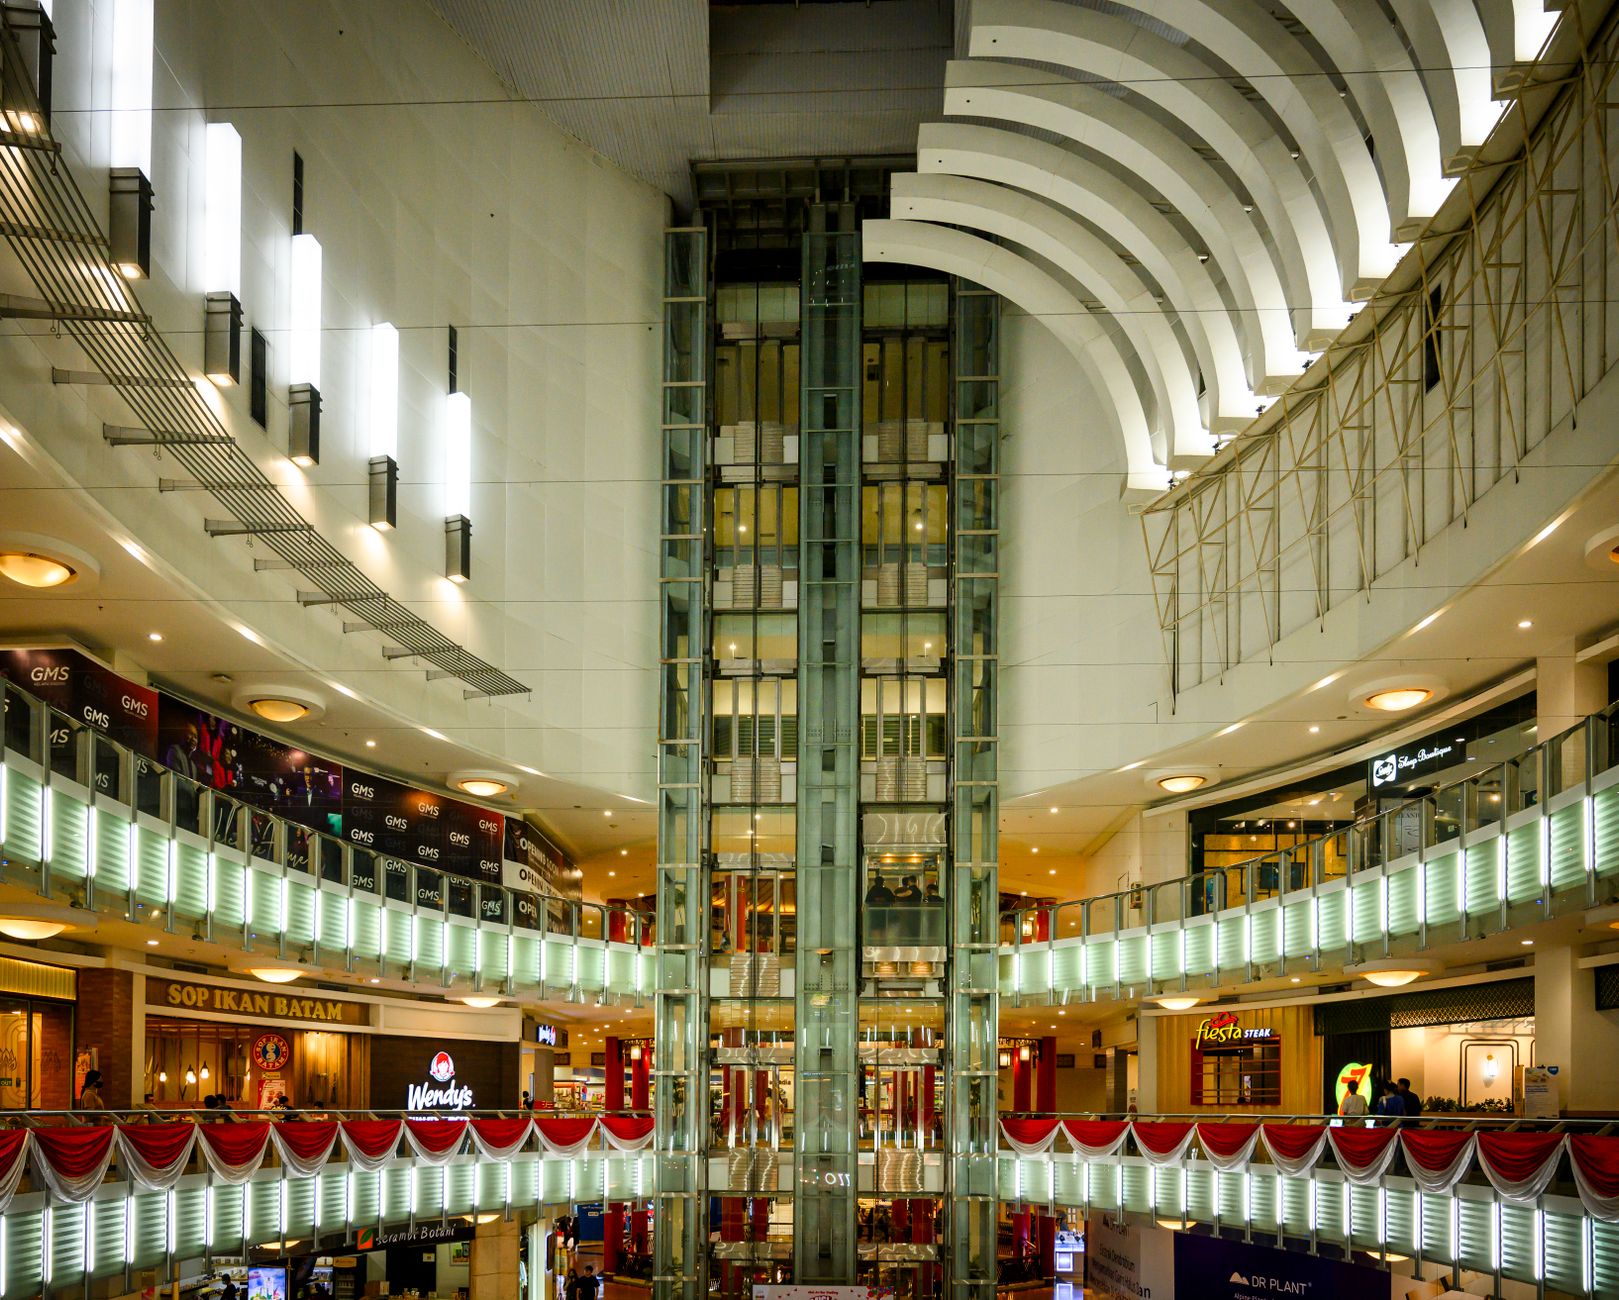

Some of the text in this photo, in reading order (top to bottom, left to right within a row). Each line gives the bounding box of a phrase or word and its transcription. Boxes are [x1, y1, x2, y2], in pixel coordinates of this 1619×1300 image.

[31, 666, 70, 681] GMS
[121, 695, 149, 717] GMS
[83, 705, 110, 728] GMS
[351, 782, 375, 798] GMS
[418, 802, 440, 816] GMS
[385, 815, 407, 830] GMS
[479, 819, 498, 833] GMS
[351, 828, 375, 844] GMS
[449, 832, 470, 845] GMS
[418, 845, 440, 859] GMS
[480, 860, 500, 873] GMS
[352, 875, 374, 888] GMS
[418, 888, 440, 901] GMS
[481, 900, 501, 914] GMS
[168, 983, 343, 1021] SOP IKAN BATAM
[1195, 1018, 1271, 1050] fiesta STEAK
[1251, 1275, 1308, 1296] DR PLANT
